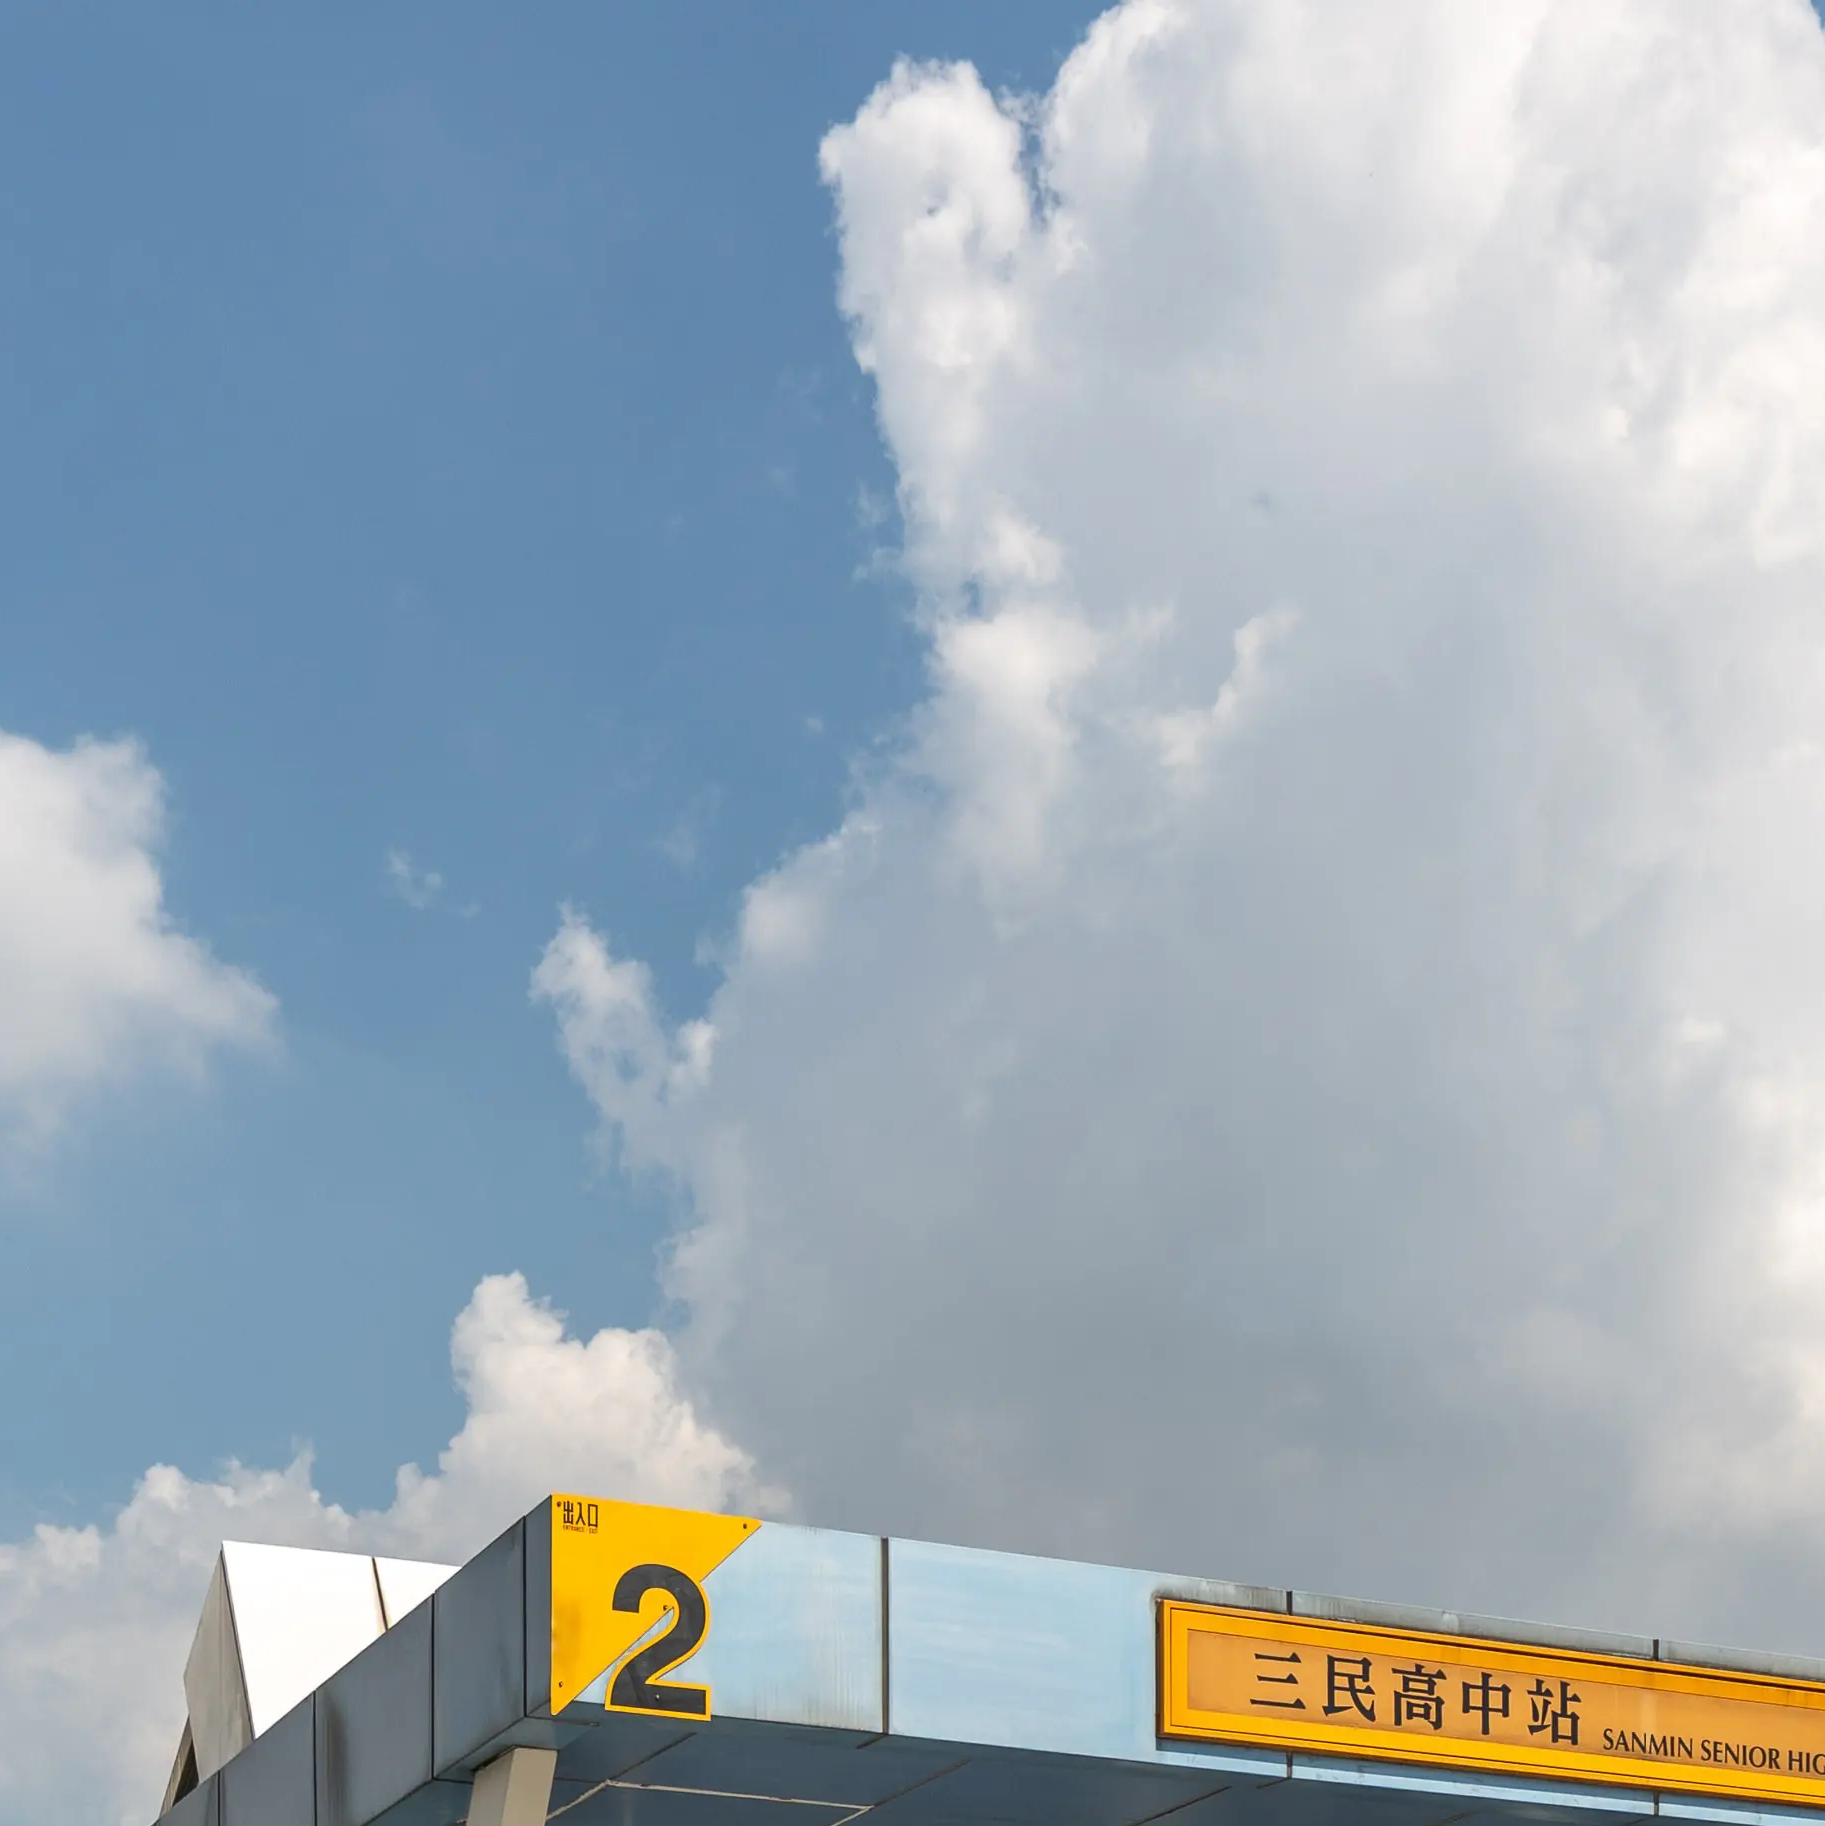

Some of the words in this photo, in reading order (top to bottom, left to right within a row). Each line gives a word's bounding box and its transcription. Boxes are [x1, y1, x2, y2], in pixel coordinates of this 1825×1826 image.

[563, 1501, 598, 1528] 出入口
[611, 1563, 707, 1714] 2
[1250, 1652, 1582, 1746] 三民高中站
[1602, 1728, 1693, 1759] SANMIN
[1701, 1740, 1780, 1770] SENIOR
